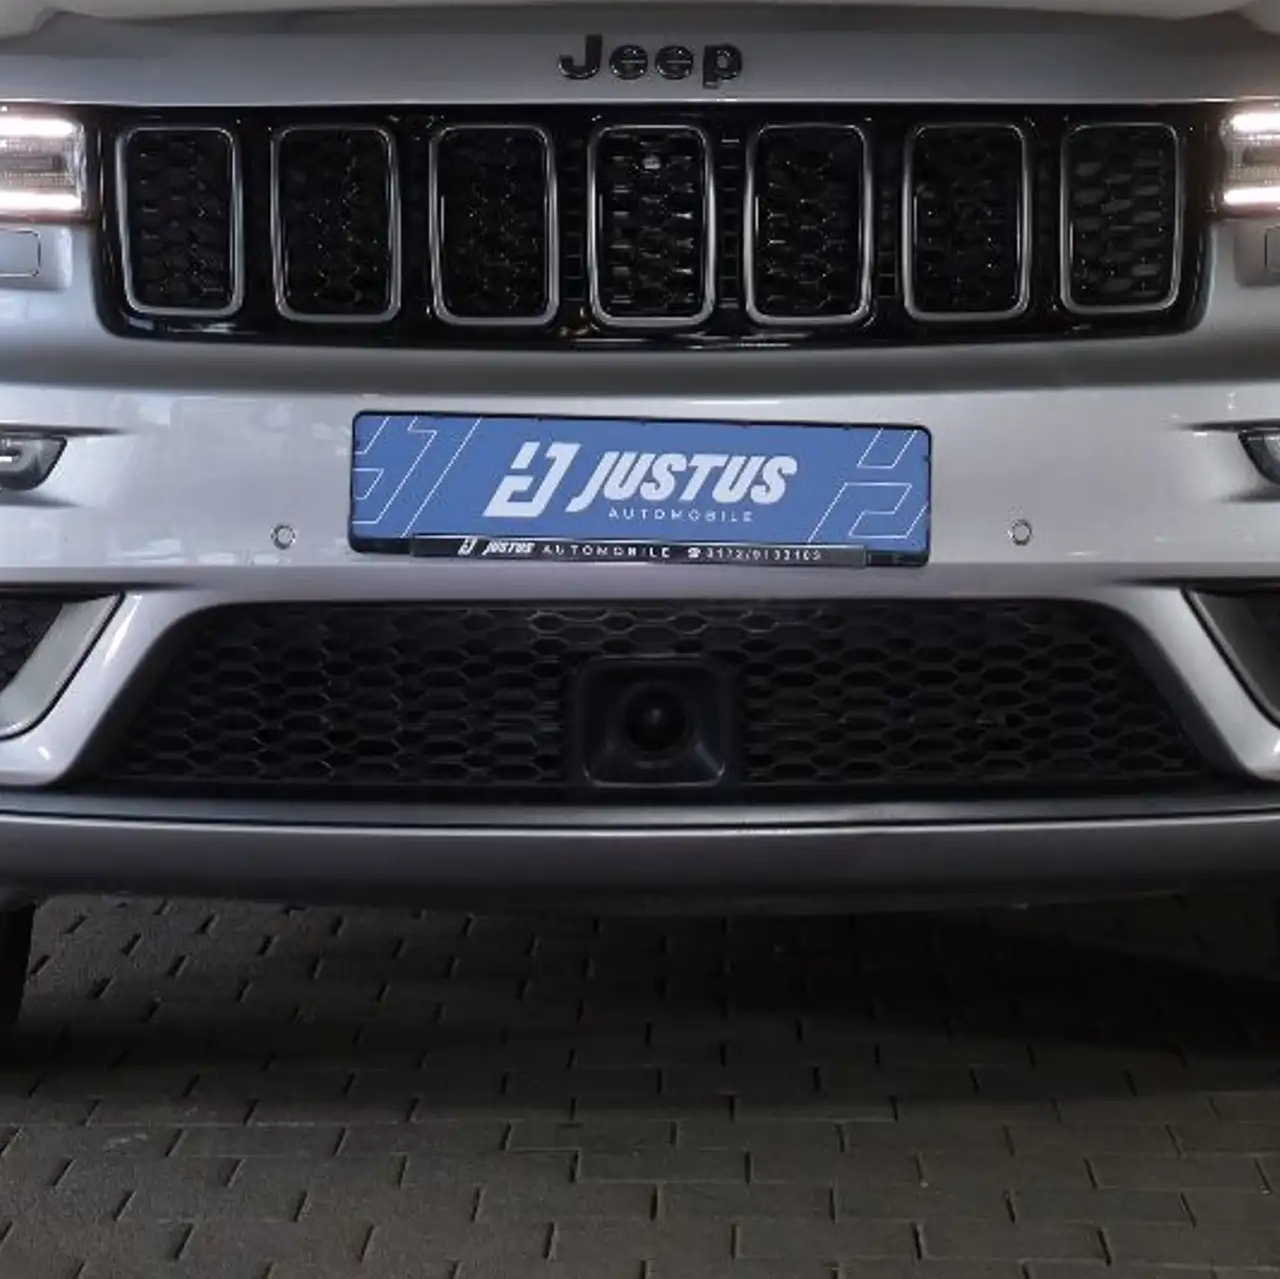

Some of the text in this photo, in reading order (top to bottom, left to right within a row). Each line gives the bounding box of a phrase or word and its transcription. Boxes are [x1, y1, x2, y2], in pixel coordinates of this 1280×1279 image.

[558, 33, 744, 90] Jeep
[565, 450, 798, 513] JUSTUS
[608, 506, 754, 523] AUTOMOBILE
[541, 544, 671, 559] AUTOMOBILE
